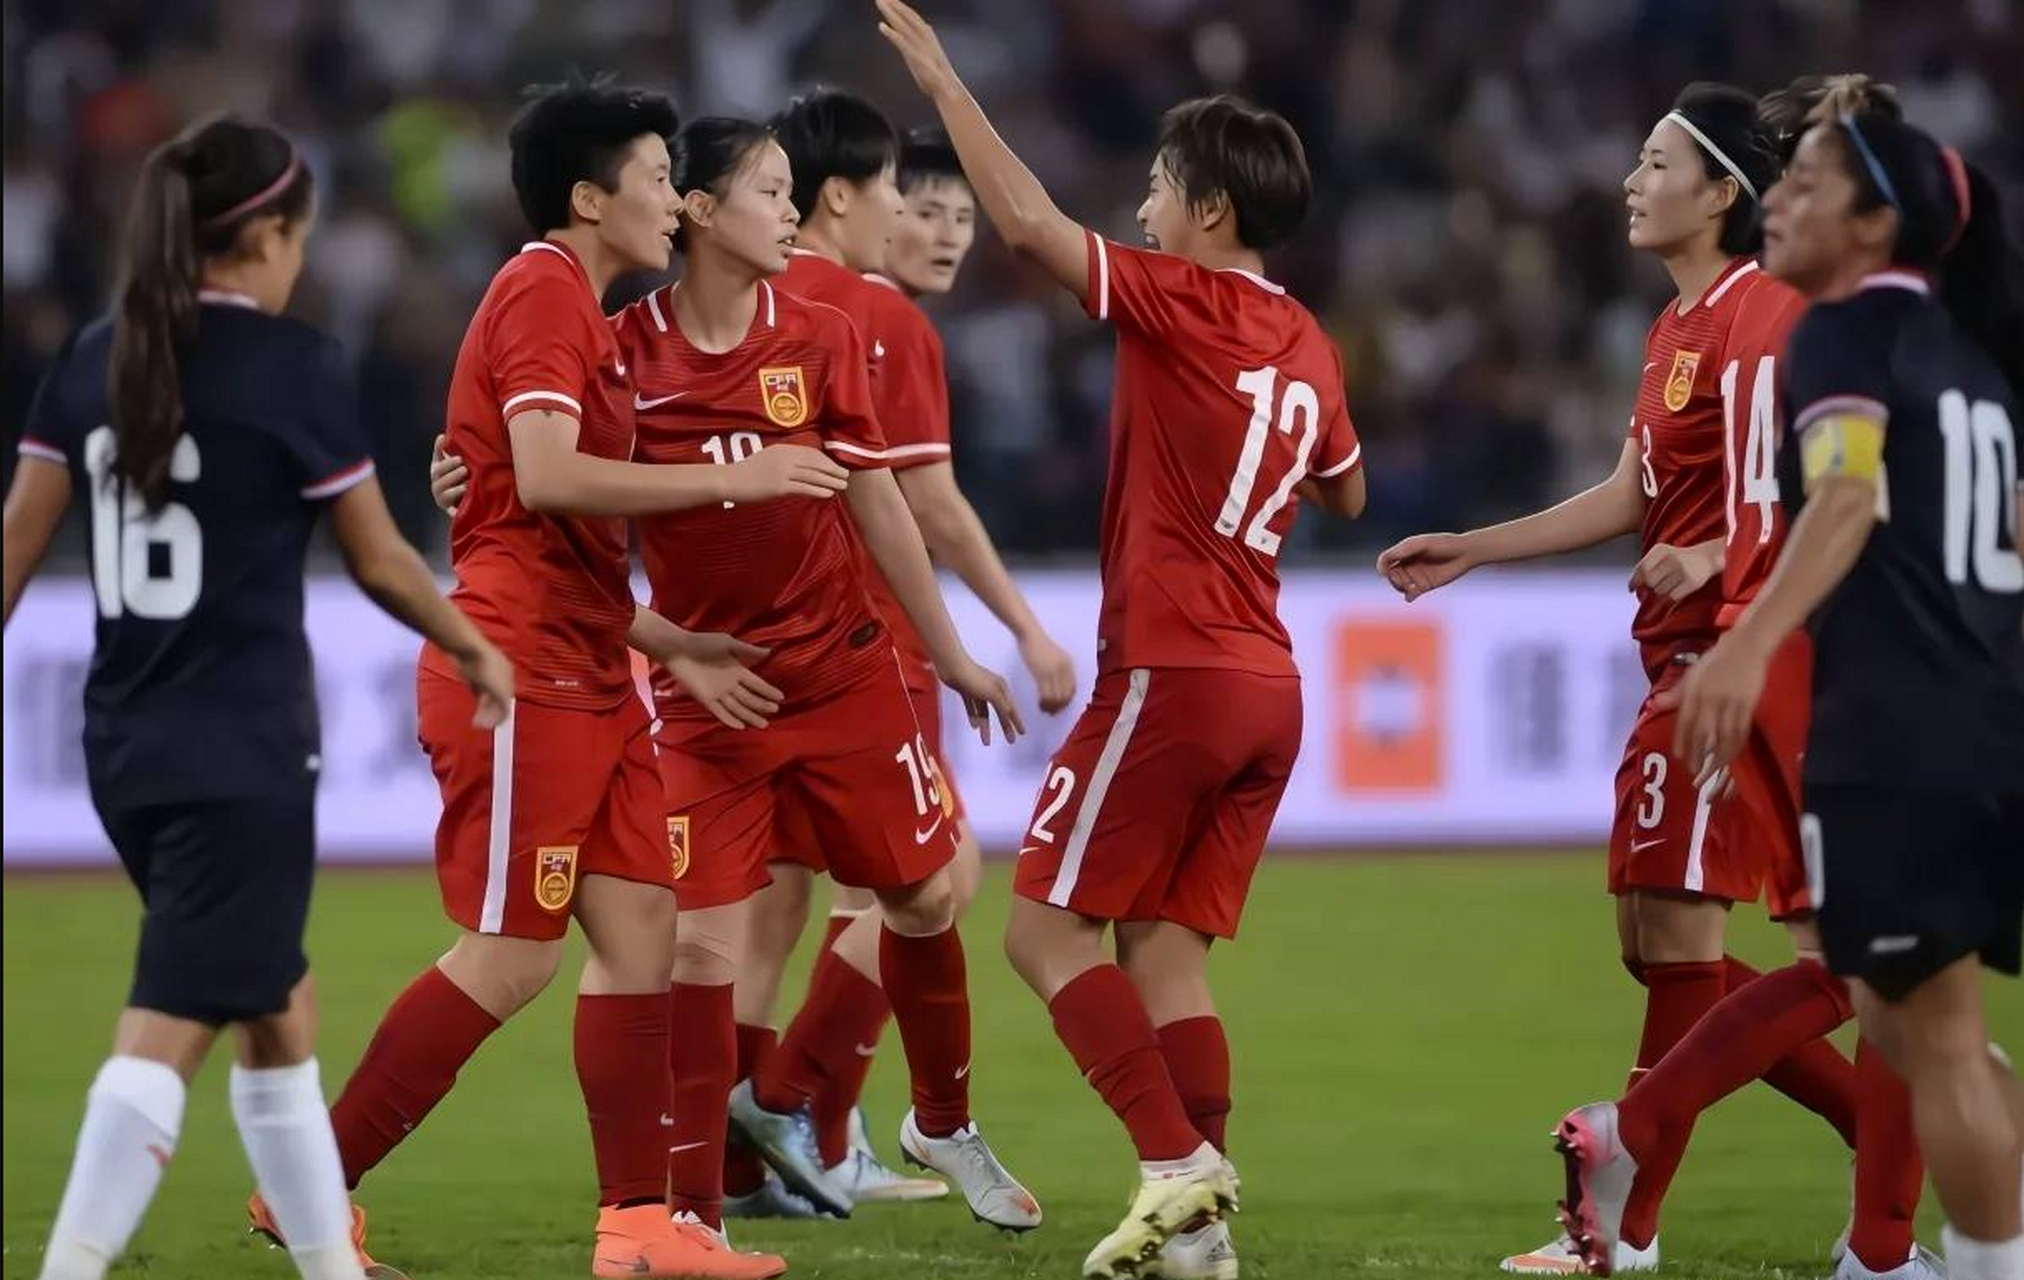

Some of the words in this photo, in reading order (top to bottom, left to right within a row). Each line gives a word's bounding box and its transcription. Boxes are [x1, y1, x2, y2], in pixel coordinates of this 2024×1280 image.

[84, 425, 203, 619] 16
[1213, 366, 1320, 557] 12
[1642, 424, 1658, 497] 3
[1720, 355, 1780, 546] 14
[1937, 387, 2024, 594] 10
[1637, 752, 1667, 828] 3
